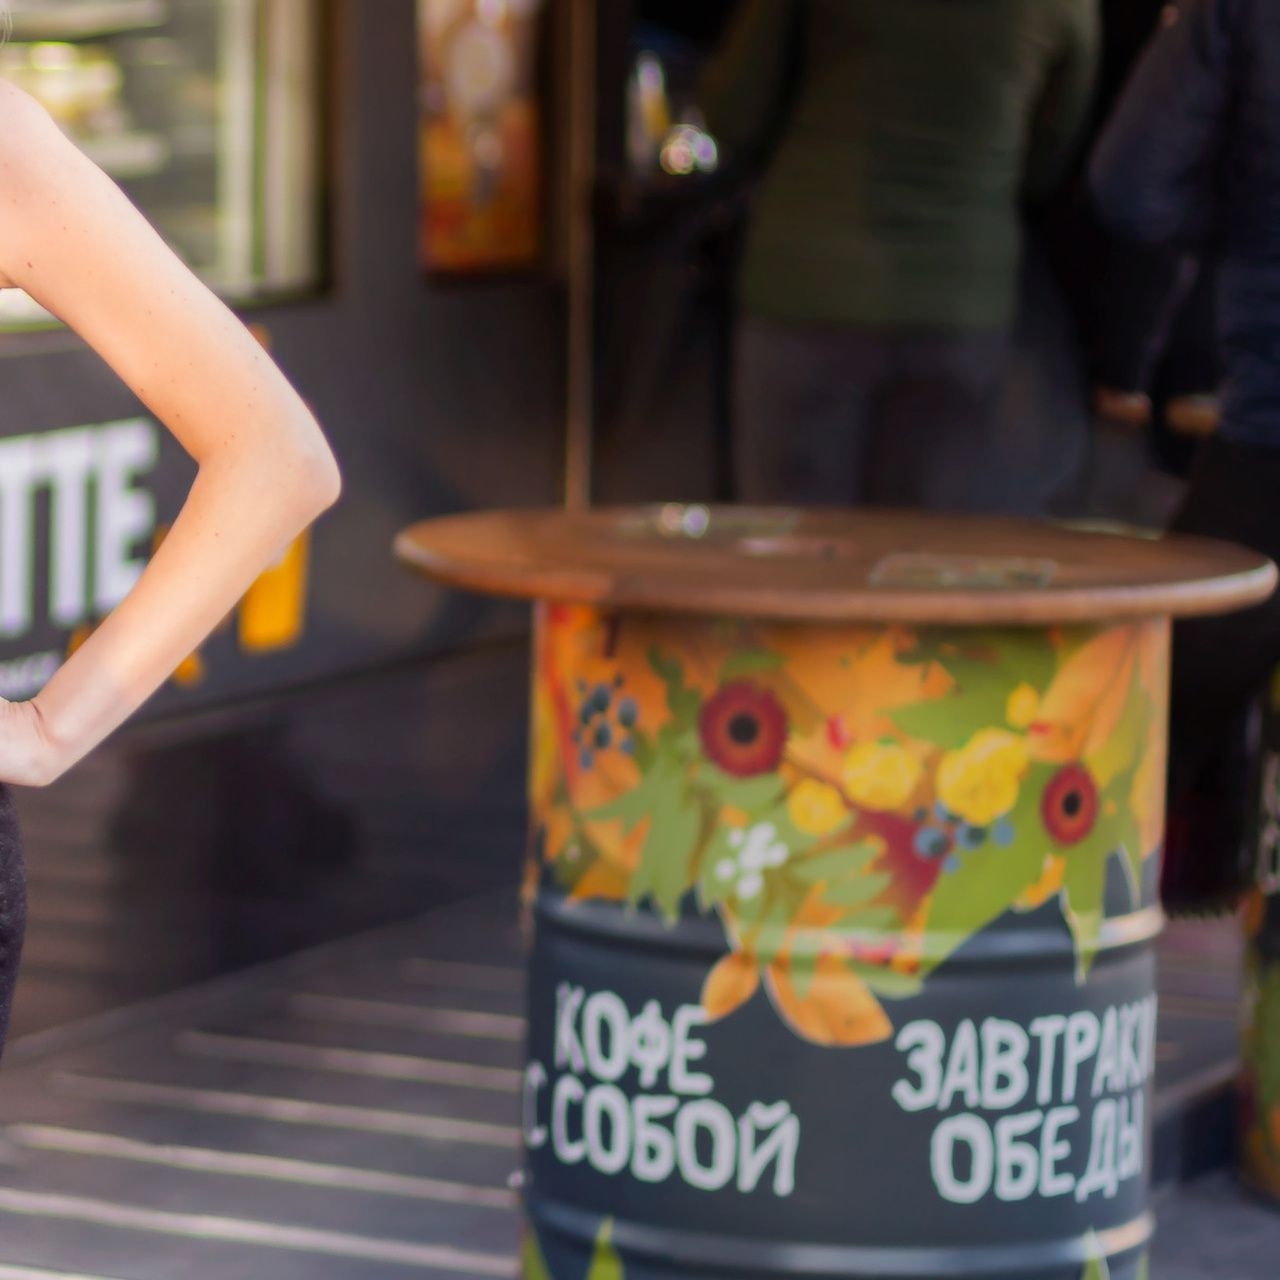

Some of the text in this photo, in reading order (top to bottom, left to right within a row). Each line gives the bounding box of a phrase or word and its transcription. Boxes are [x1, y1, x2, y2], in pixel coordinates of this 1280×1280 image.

[555, 982, 714, 1096] КОФЕ
[523, 1060, 800, 1197] С СОБОЙ
[930, 1088, 1144, 1204] ОБЕДЫ
